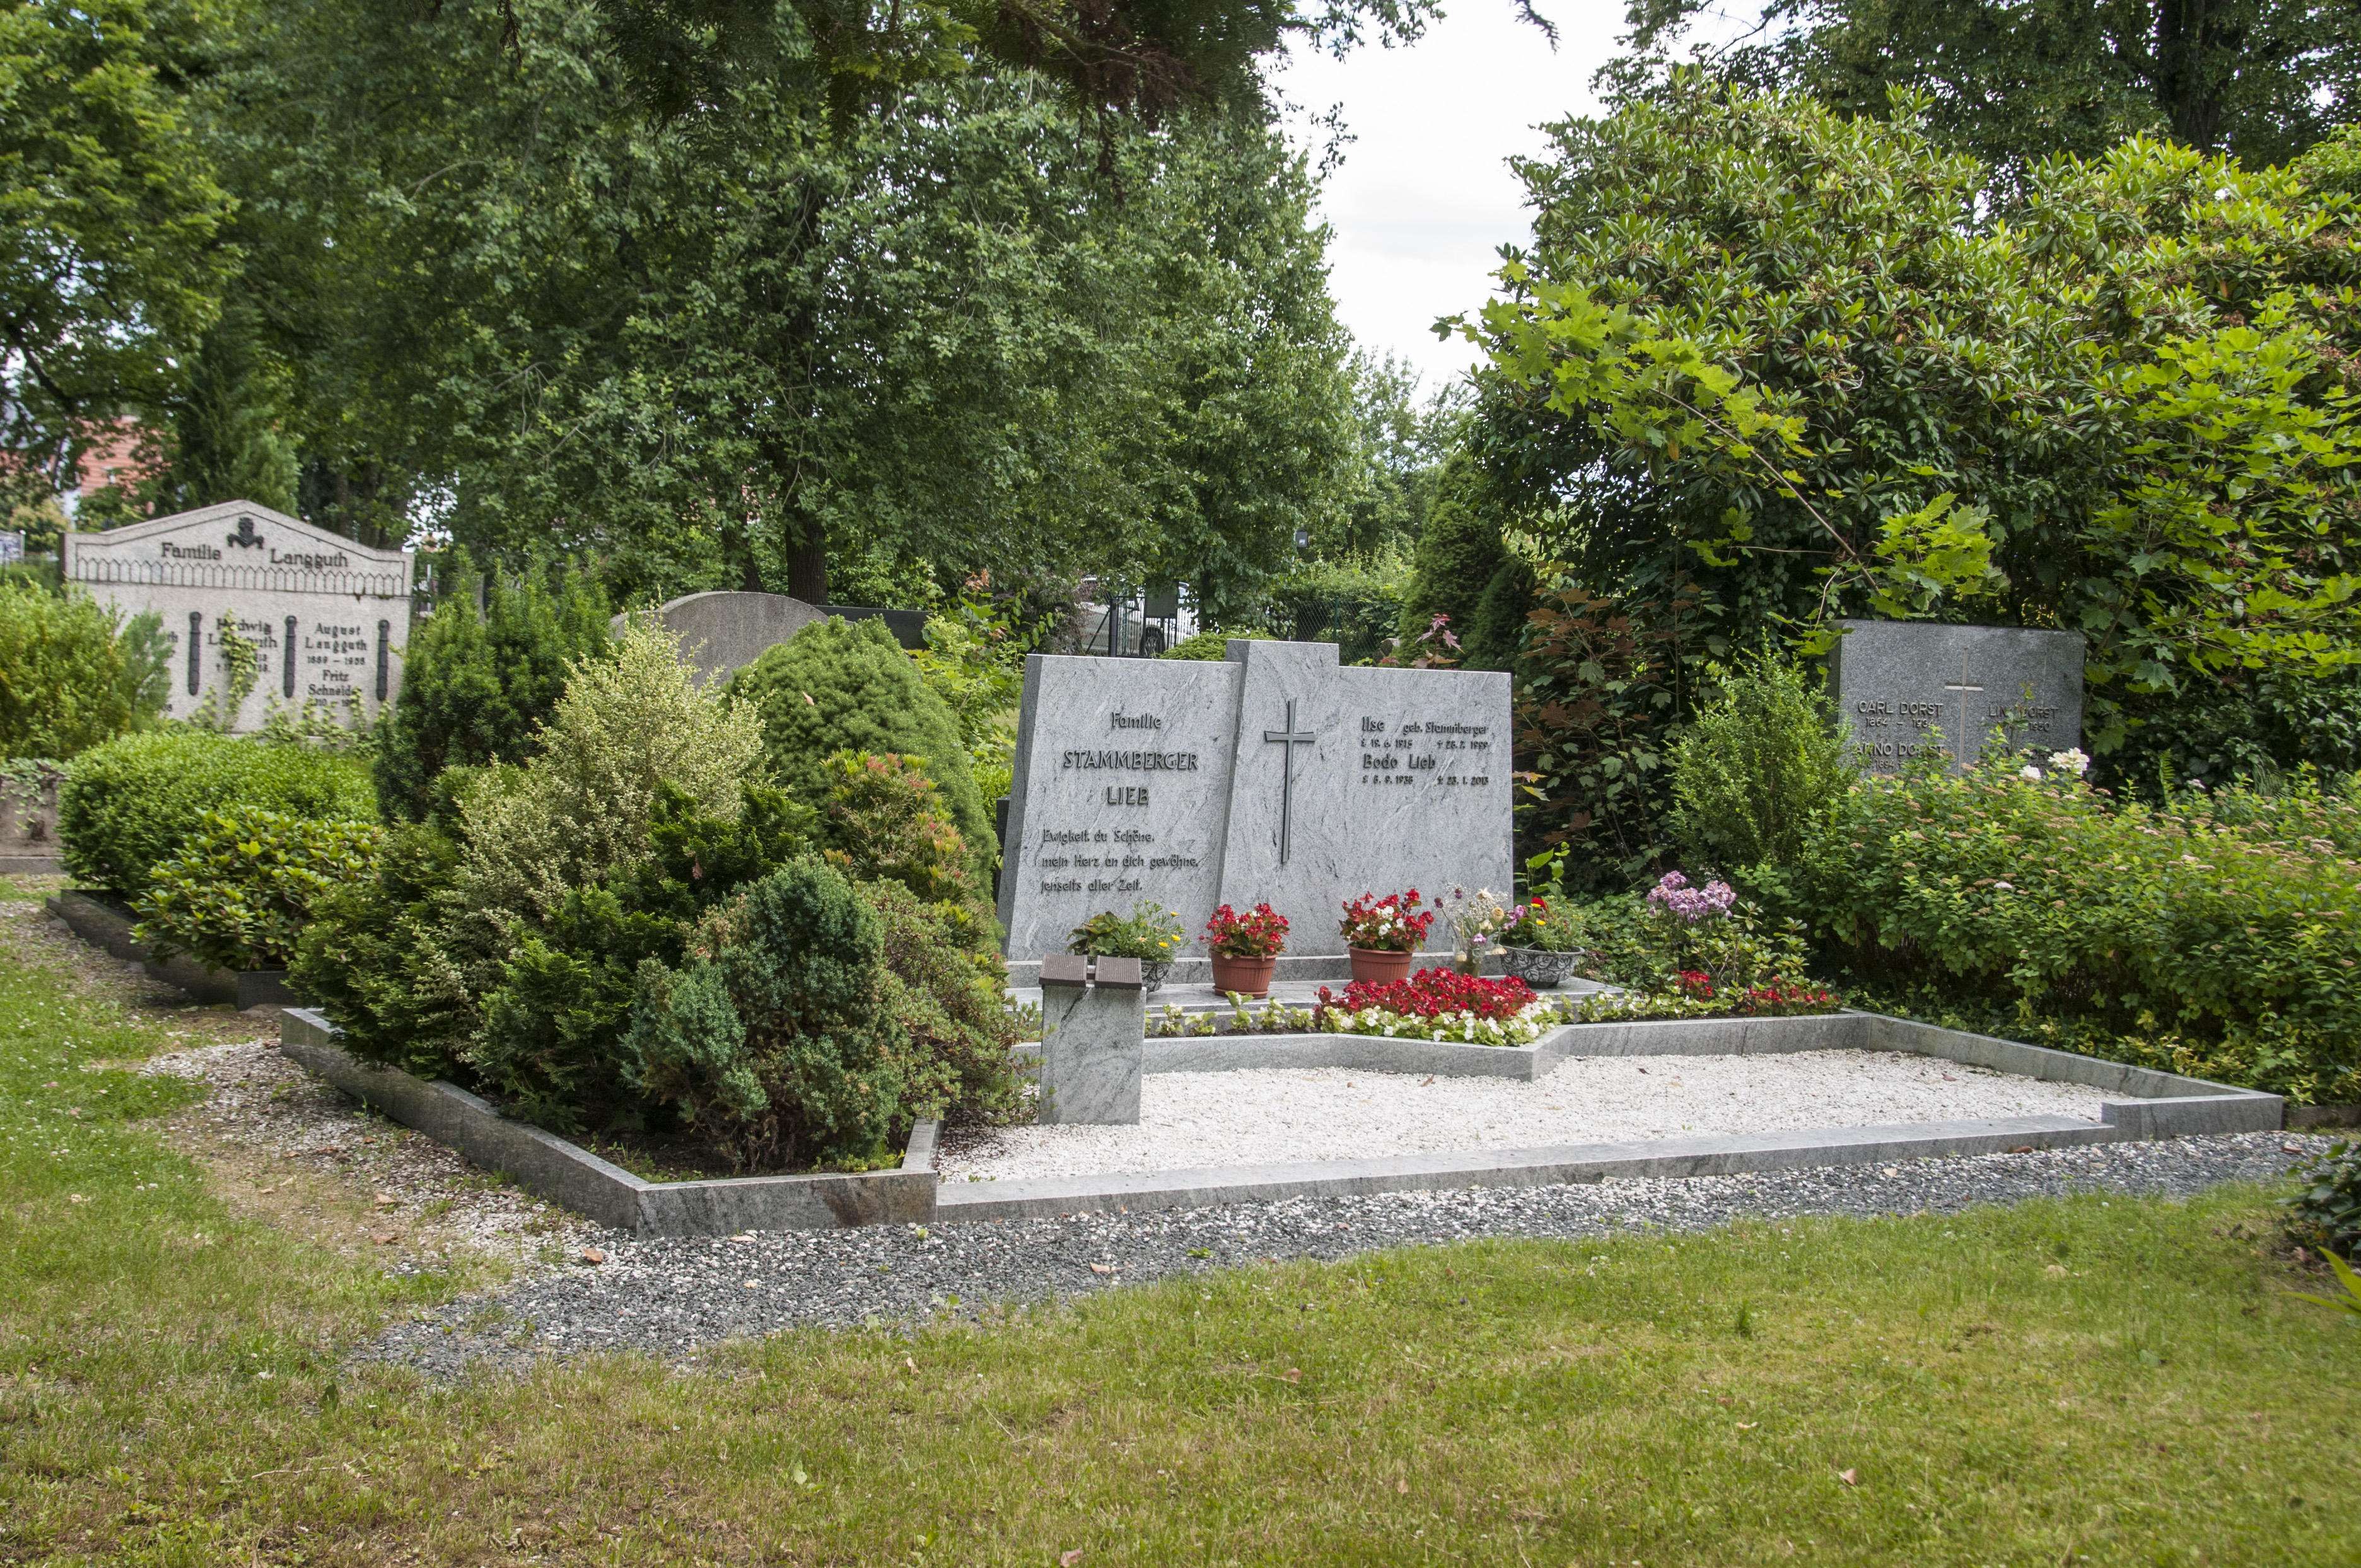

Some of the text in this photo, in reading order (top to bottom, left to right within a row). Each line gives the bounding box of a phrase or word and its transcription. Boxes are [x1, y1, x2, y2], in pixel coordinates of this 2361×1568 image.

[161, 542, 348, 567] Familie Langguth
[315, 622, 360, 638] August
[305, 636, 367, 653] Langguth
[322, 669, 349, 682] Fritz
[1858, 700, 1944, 717] CARL DORST
[1988, 705, 2014, 717] LIN
[1111, 712, 1162, 729] Familie
[1361, 716, 1489, 738] Ilse geb. Stammberger
[1866, 717, 1889, 726] 1864
[1912, 718, 1935, 728] 1934
[2029, 721, 2049, 731] 1950
[1063, 749, 1199, 770] STAMMBERGER
[1363, 753, 1435, 769] Bodo Lieb
[1107, 786, 1149, 805] LIEB
[1094, 830, 1107, 842] du
[1042, 856, 1068, 867] mein
[1075, 854, 1100, 867] Herz
[1105, 857, 1118, 867] an
[1122, 854, 1144, 867] dich
[1088, 879, 1114, 891] aller
[1118, 879, 1143, 891] Zeit.
